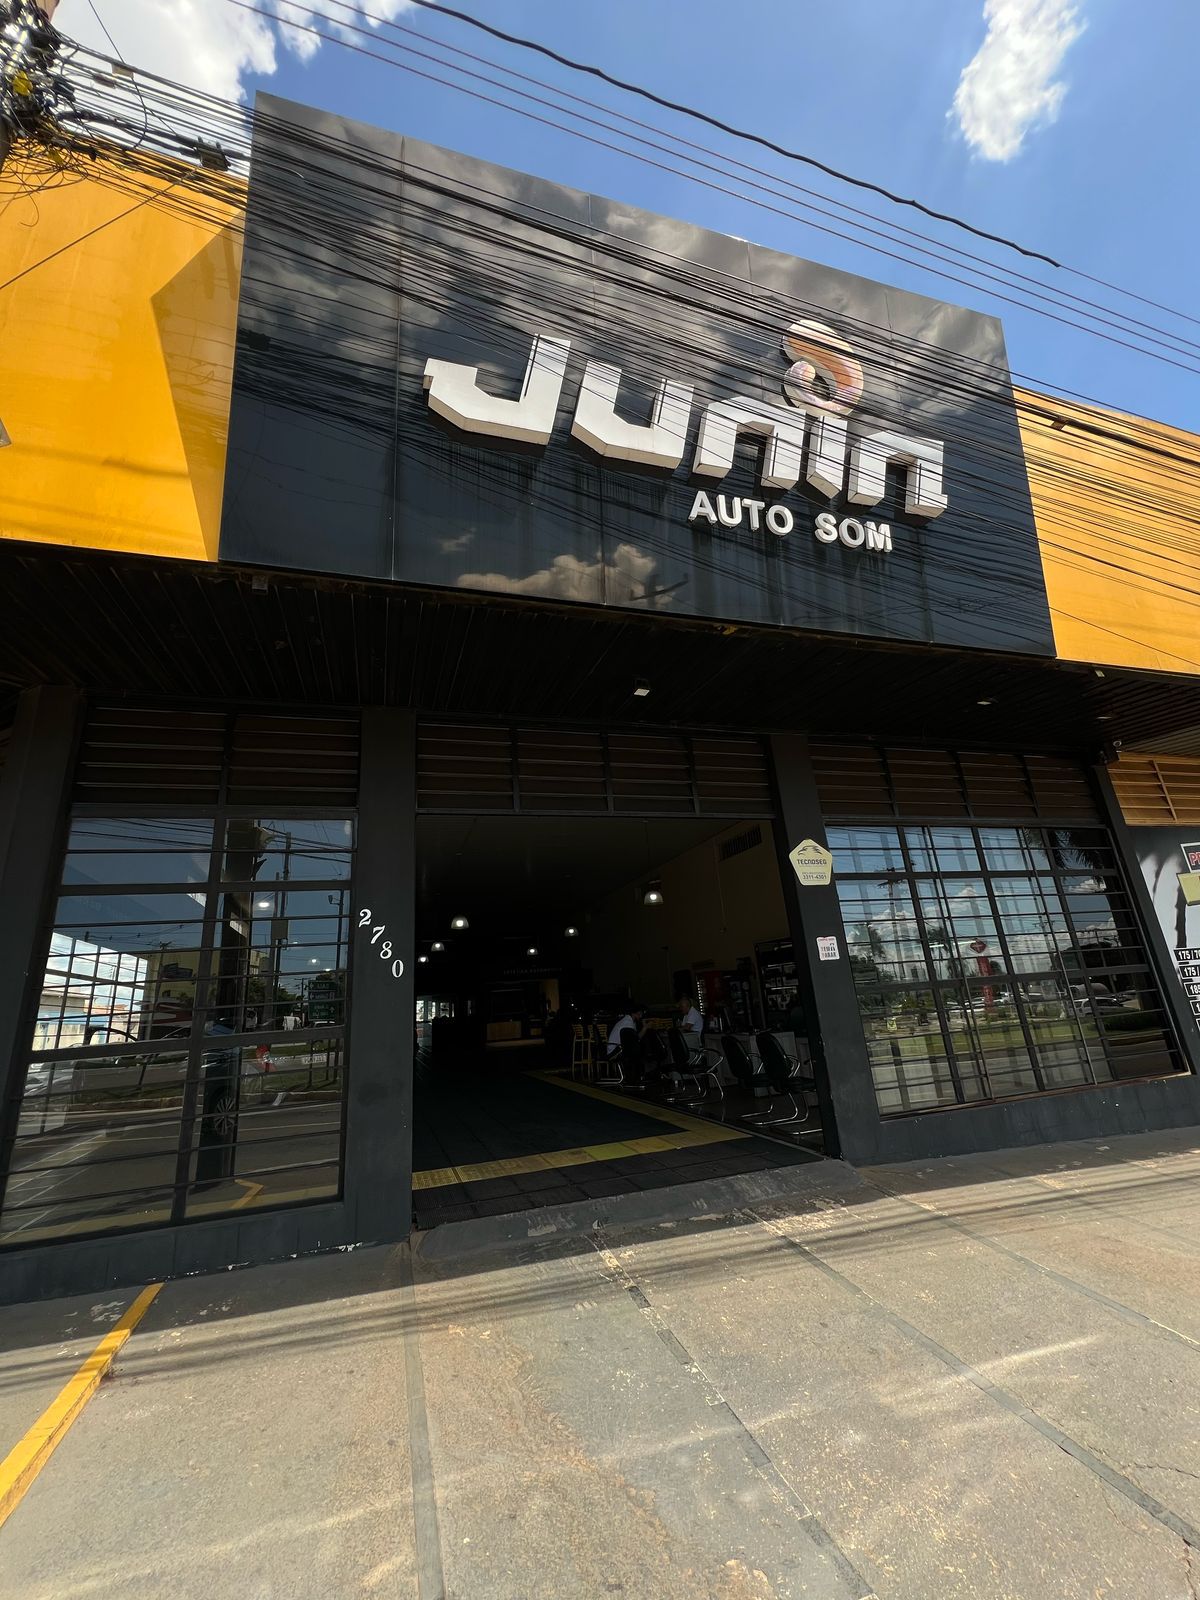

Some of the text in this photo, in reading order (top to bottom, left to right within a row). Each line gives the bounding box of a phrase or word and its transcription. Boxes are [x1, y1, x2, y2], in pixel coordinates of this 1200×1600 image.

[688, 490, 893, 552] AUTO SOM
[358, 908, 404, 978] 2780
